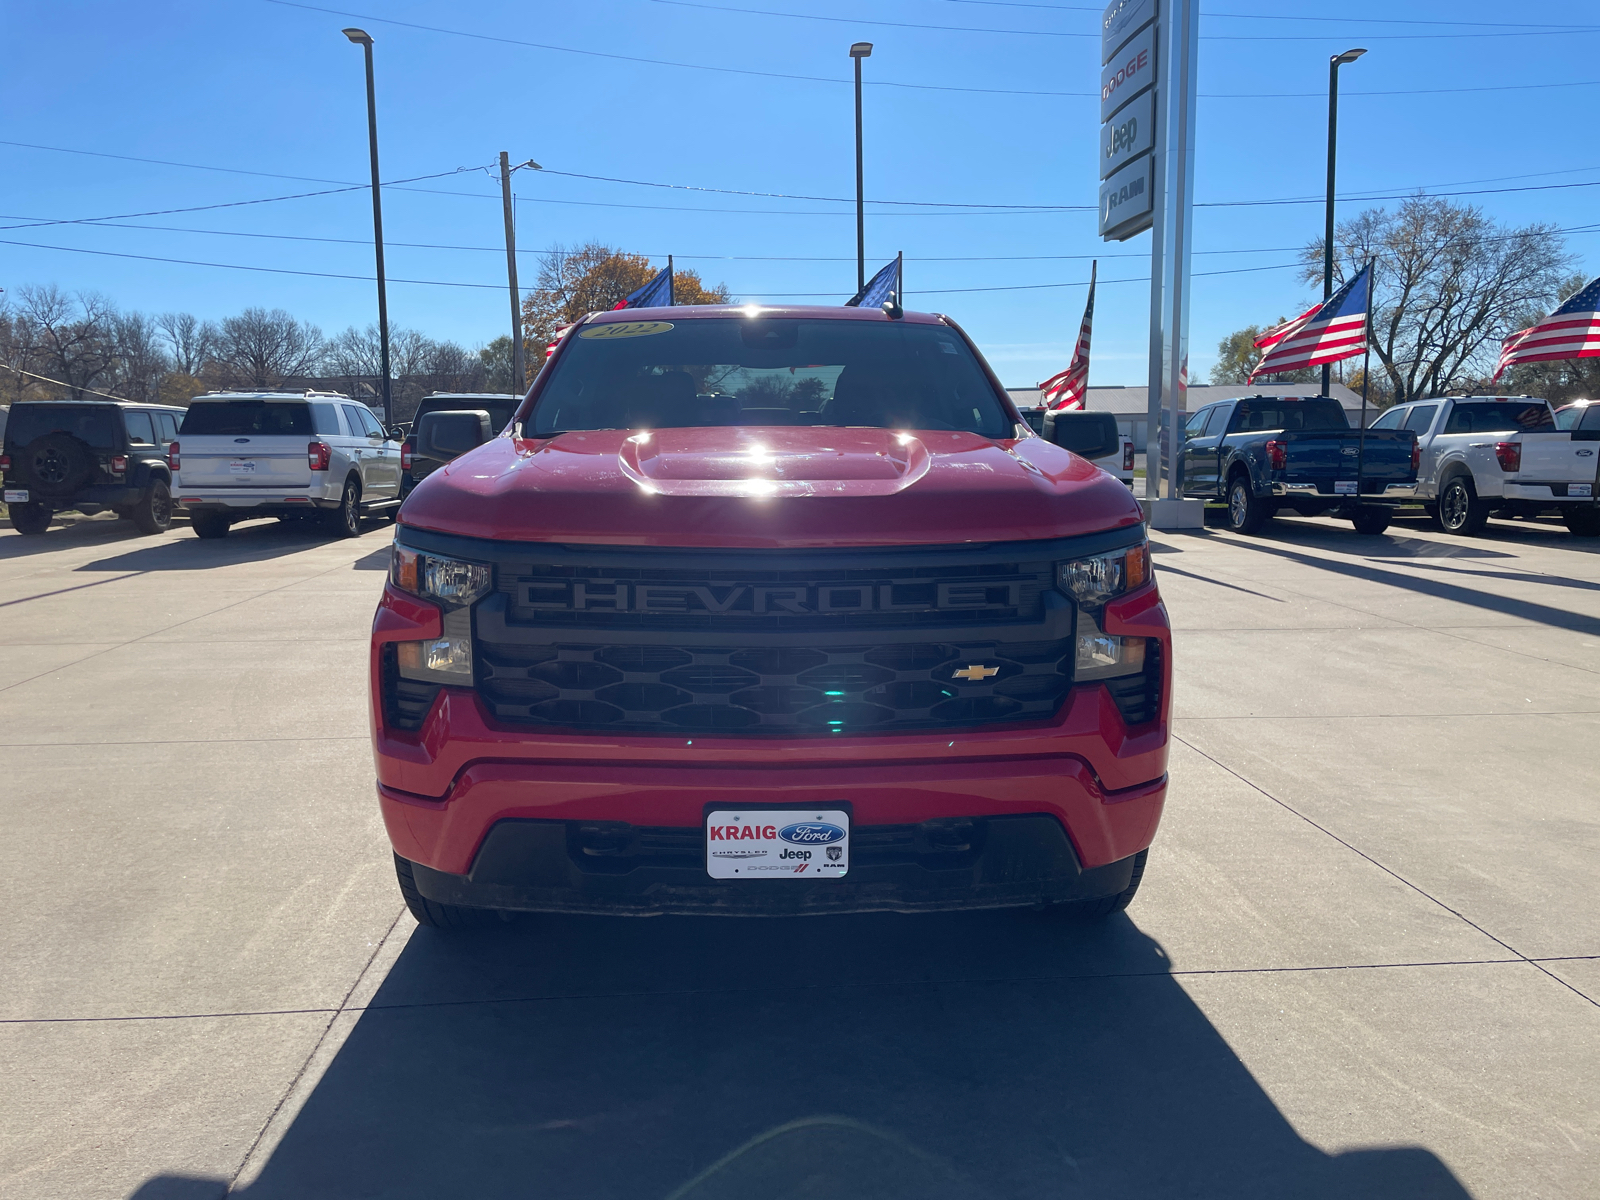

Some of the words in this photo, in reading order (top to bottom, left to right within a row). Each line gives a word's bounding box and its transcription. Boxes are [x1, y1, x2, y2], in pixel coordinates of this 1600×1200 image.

[1102, 49, 1148, 102] DODGE
[1106, 117, 1137, 158] Jeep
[1110, 176, 1145, 210] RAM
[593, 323, 659, 337] 2022
[516, 574, 1038, 612] CHEVROLET
[710, 825, 777, 841] KRAIG
[791, 825, 832, 842] Ford
[779, 848, 812, 861] Jeep
